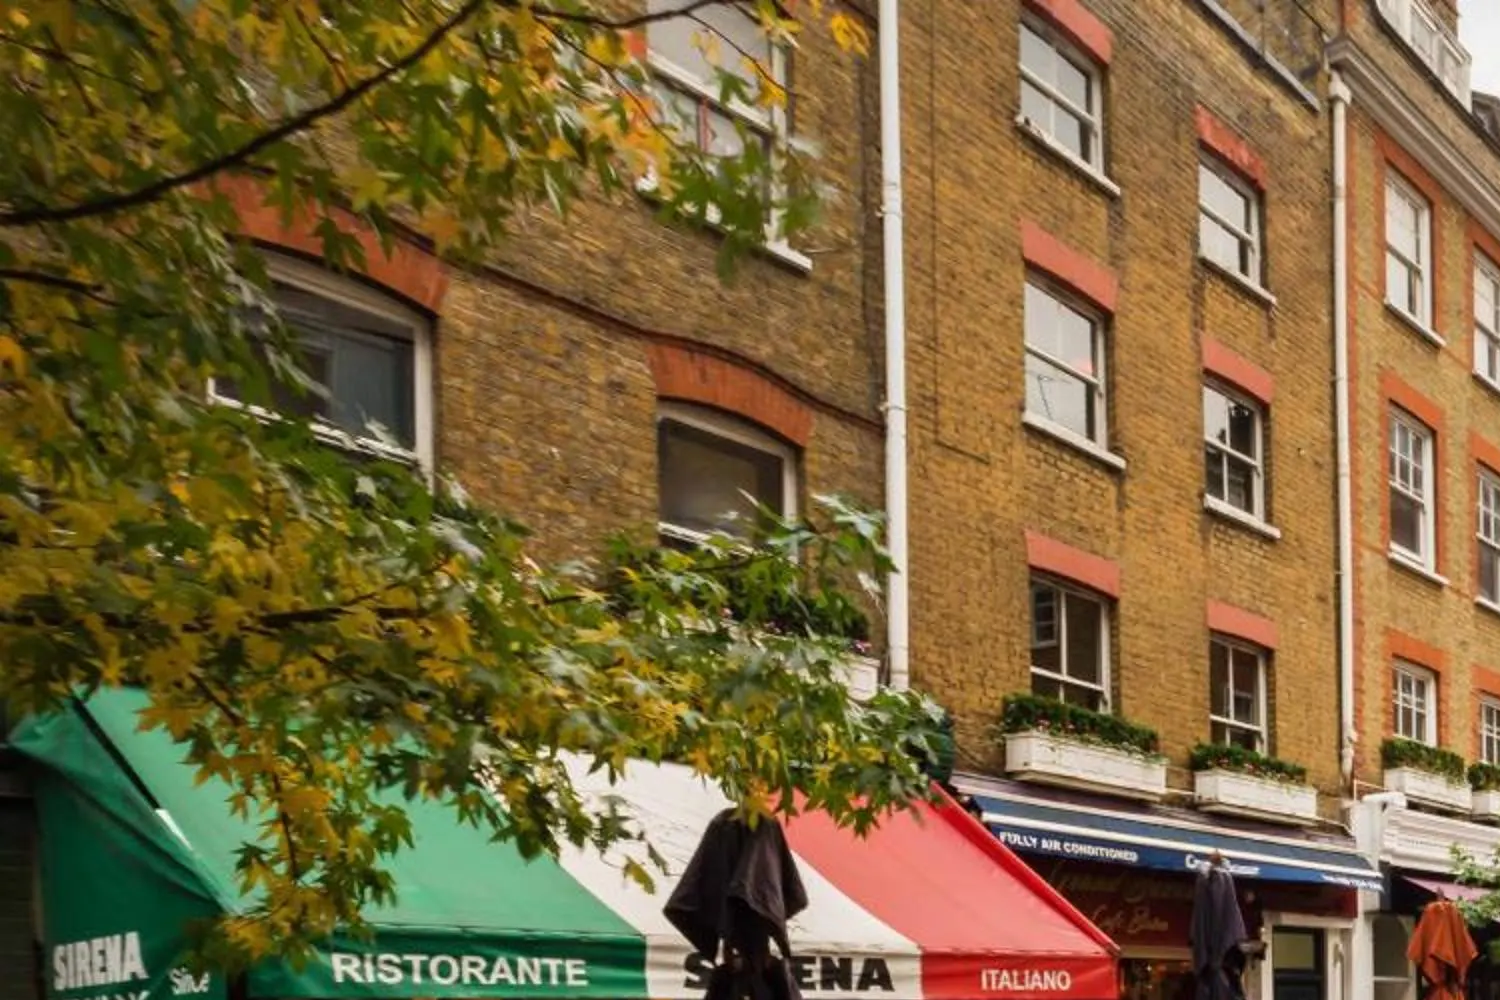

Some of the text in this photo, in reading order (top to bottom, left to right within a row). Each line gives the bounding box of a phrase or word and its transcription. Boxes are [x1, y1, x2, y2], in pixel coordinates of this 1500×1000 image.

[1041, 839, 1061, 851] AIR
[1063, 842, 1138, 862] CONDITIONED
[54, 931, 149, 991] SIRENA
[331, 953, 589, 986] RISTORANTE
[683, 952, 896, 992] SENA
[981, 968, 1072, 992] ITALIANO
